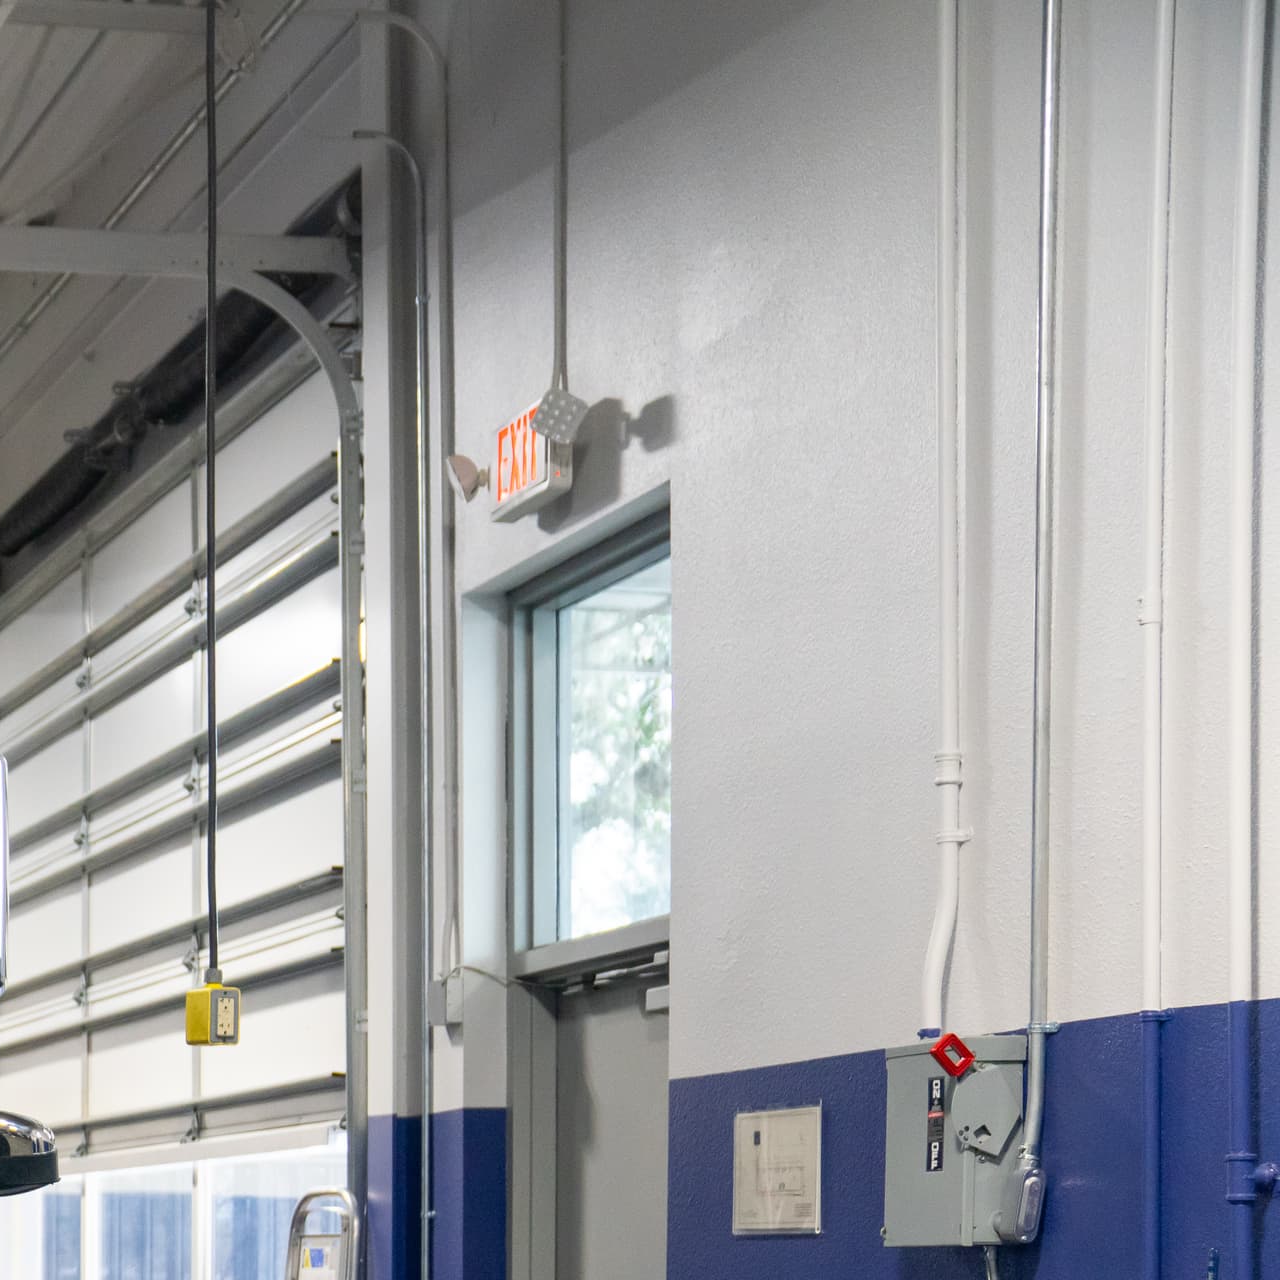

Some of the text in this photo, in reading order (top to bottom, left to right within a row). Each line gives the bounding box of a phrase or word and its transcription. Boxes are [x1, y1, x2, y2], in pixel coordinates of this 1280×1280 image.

[497, 405, 538, 503] EXIT
[932, 1079, 941, 1099] ON
[930, 1141, 939, 1170] OFF
